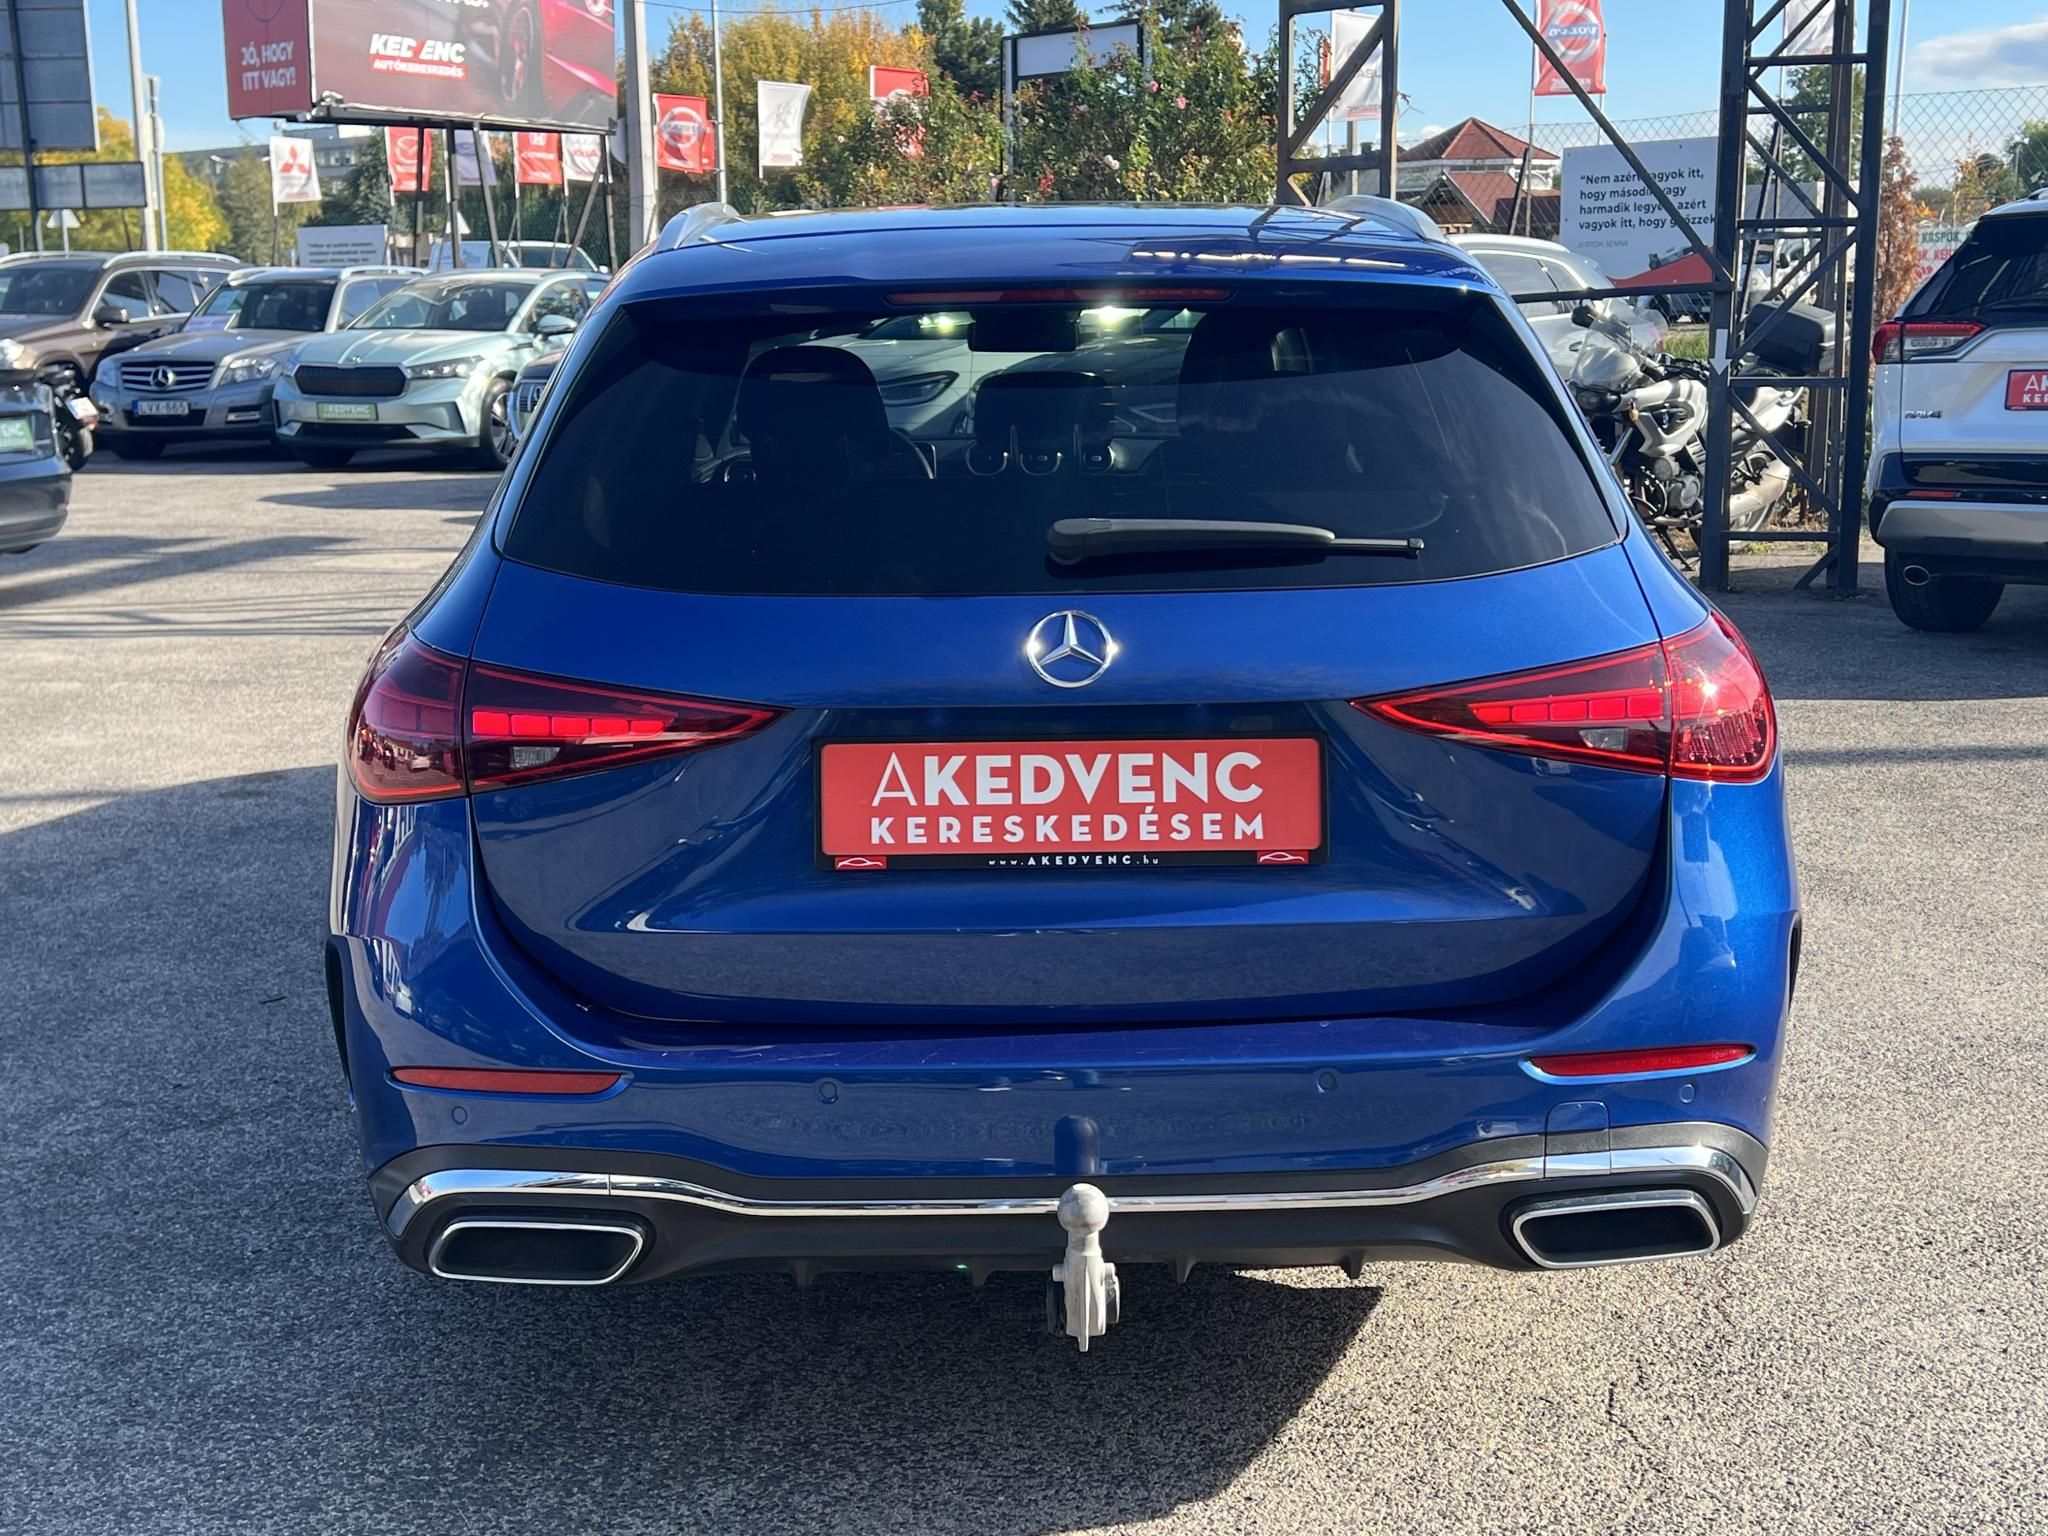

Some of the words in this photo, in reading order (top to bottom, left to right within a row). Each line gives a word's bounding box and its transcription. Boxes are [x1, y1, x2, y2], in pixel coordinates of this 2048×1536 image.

[241, 41, 260, 67] JÓ,
[261, 41, 295, 62] HOGY
[242, 70, 263, 91] ITT
[262, 67, 297, 87] VAGY!
[1688, 167, 1704, 179] itt,
[1580, 190, 1607, 201] hogy
[1579, 203, 1630, 215] harmadik
[1633, 202, 1664, 214] legye
[1677, 198, 1707, 209] azért
[1578, 219, 1618, 231] vagyok
[1620, 217, 1636, 229] itt,
[1639, 216, 1667, 228] hogy
[871, 751, 1264, 806] AKEDVENC
[870, 806, 1264, 844] KERESKEDÉSEM
[988, 854, 1160, 867] www.AKEDVENC.hu
